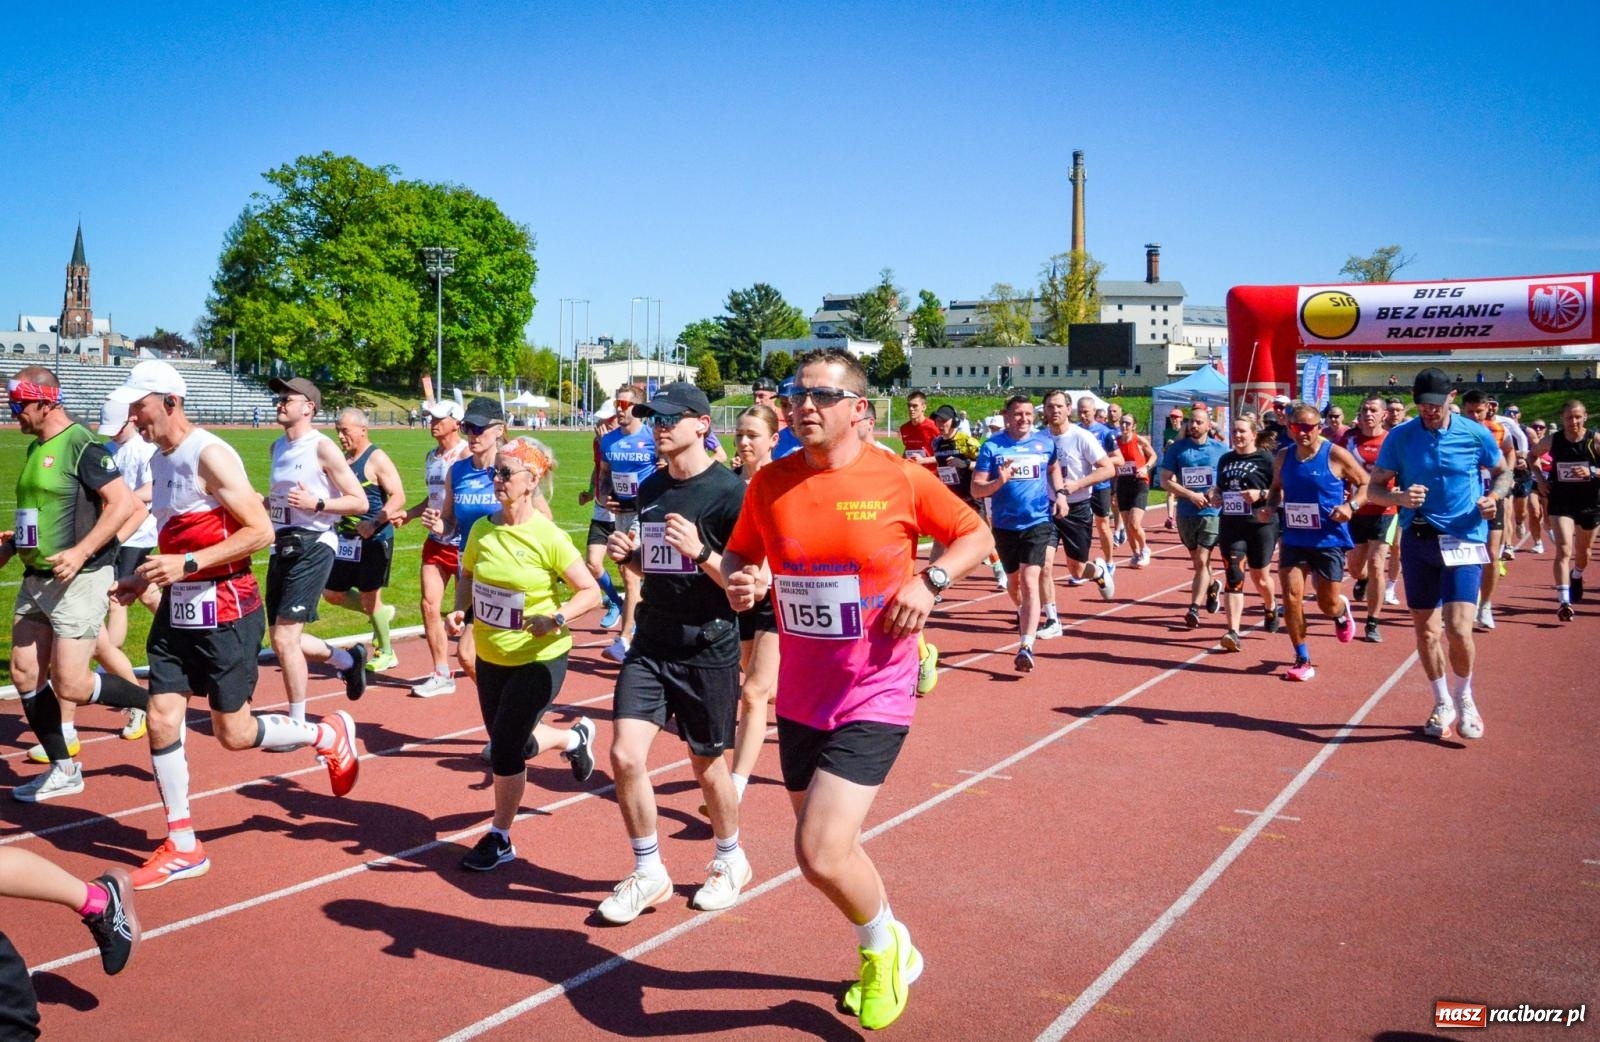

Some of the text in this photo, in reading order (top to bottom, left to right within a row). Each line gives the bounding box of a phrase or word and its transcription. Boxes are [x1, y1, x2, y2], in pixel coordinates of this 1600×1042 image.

[1414, 288, 1465, 299] BIEG
[1376, 303, 1504, 320] BEZ GRANIC
[1386, 322, 1493, 339] RACIBÓRZ
[1187, 475, 1204, 484] 220
[836, 501, 888, 511] SZWAGRY
[1225, 502, 1242, 511] 206
[846, 511, 877, 521] TEAM
[1291, 514, 1309, 524] 143
[651, 545, 672, 564] 211
[816, 581, 839, 589] GRANIC
[860, 595, 885, 610] KIE
[174, 603, 196, 620] 218
[480, 601, 503, 621] 177
[789, 604, 833, 628] 155
